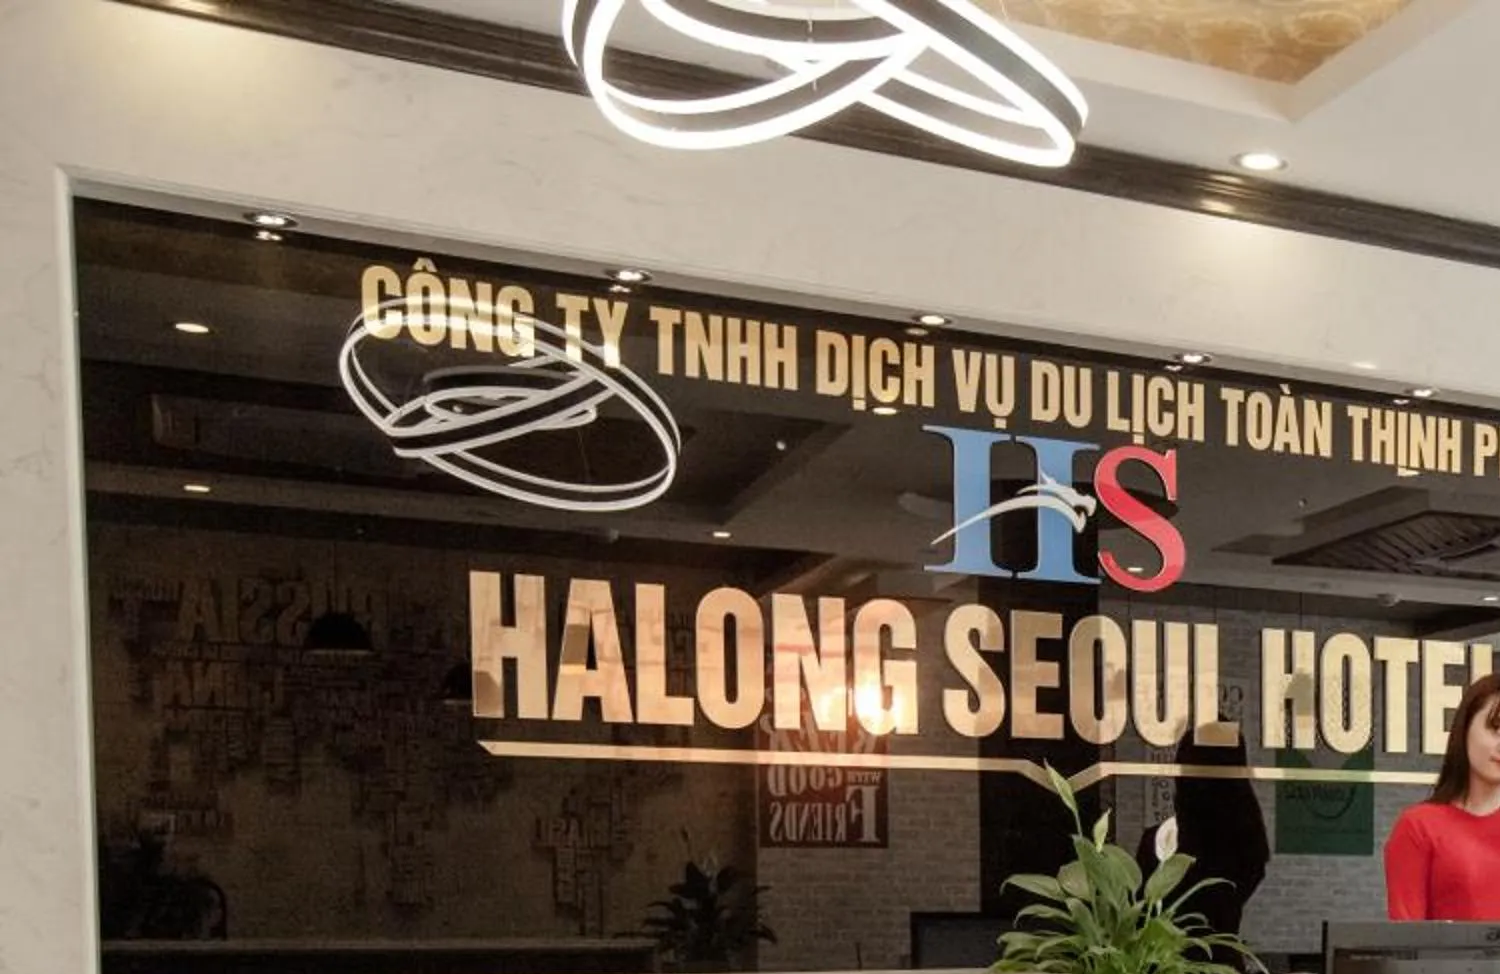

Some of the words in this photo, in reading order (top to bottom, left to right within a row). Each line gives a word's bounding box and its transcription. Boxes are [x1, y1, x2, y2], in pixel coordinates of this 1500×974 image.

[361, 258, 535, 358] CÔNG
[650, 305, 799, 391] TNHH
[816, 329, 936, 411] DỊCH
[952, 348, 1016, 428] VỤ
[1031, 359, 1093, 429] DU
[1107, 370, 1206, 445] LỊCH
[1220, 383, 1333, 458] TOÀN
[1347, 404, 1462, 476] THỊNH
[469, 570, 919, 737] HALONG
[943, 603, 1240, 747] SEOUL
